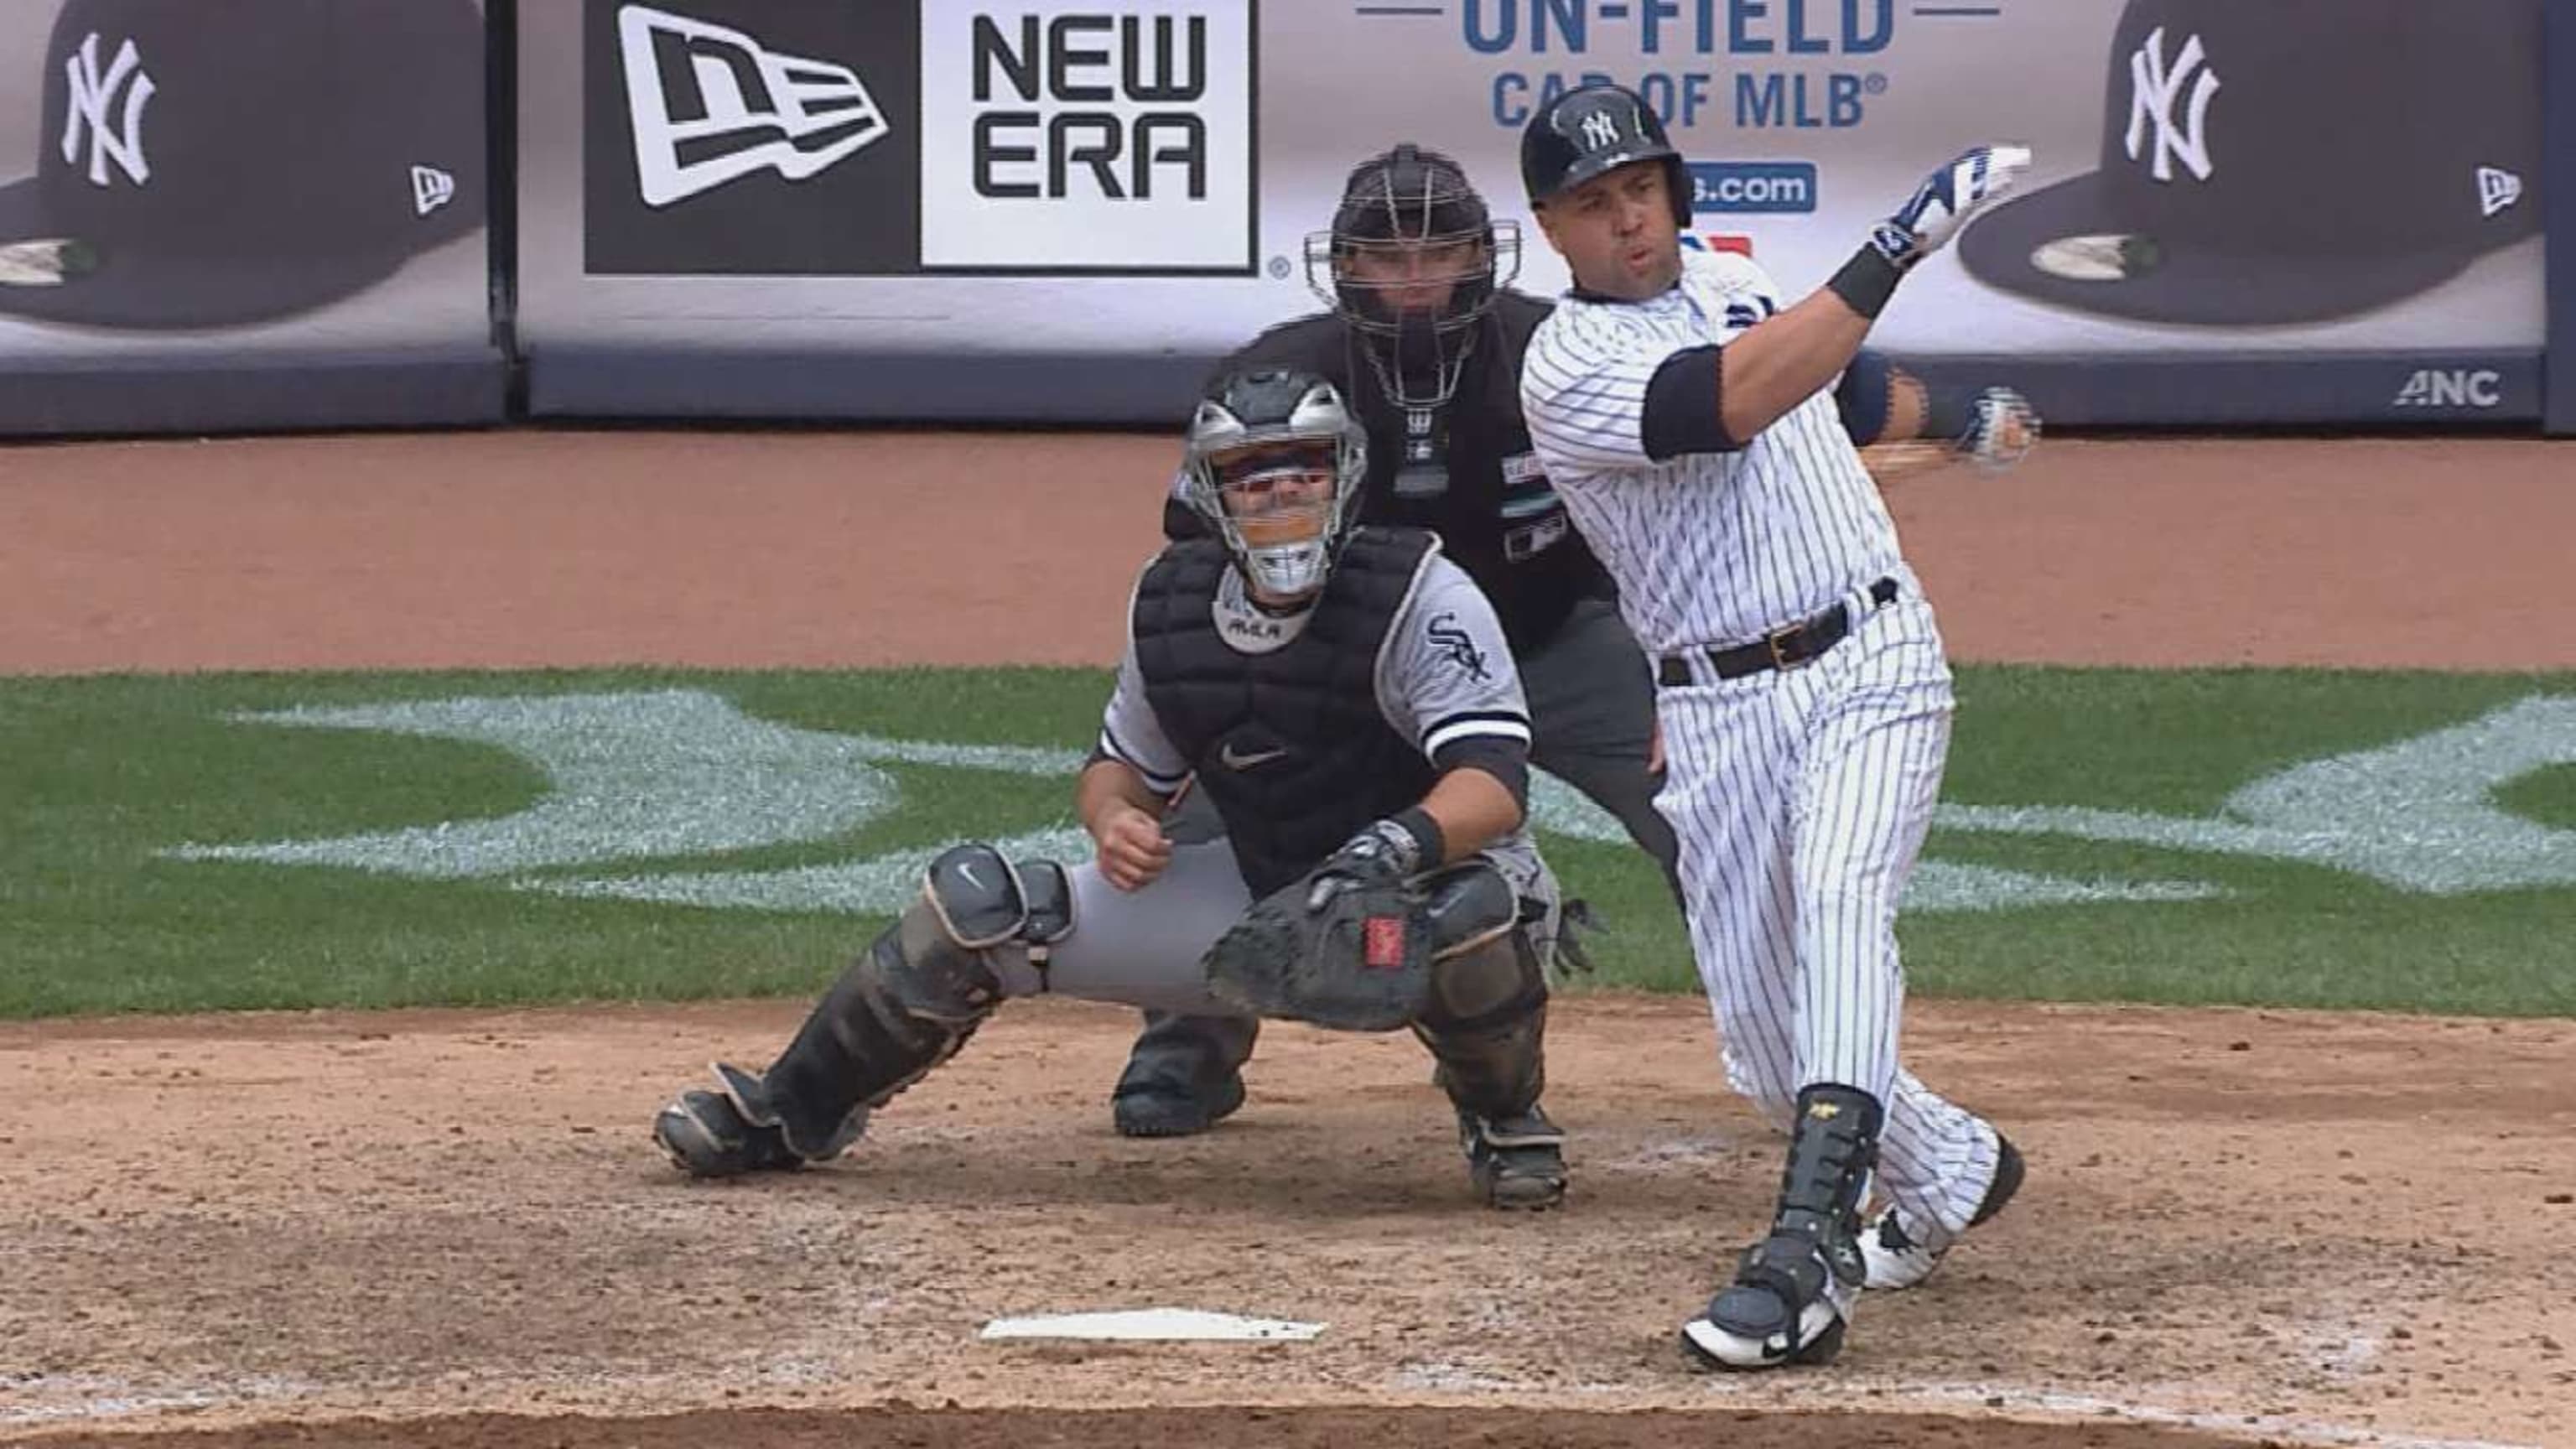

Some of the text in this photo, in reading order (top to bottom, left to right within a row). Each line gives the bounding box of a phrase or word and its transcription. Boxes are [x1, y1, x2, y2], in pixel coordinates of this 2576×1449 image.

[972, 14, 1207, 102] NEW
[1462, 0, 1894, 55] ON-FIELD
[61, 31, 158, 187] NY
[1641, 72, 1710, 127] OF
[2124, 26, 2221, 182] NY
[972, 111, 1207, 200] ERA
[2393, 369, 2500, 406] ANC
